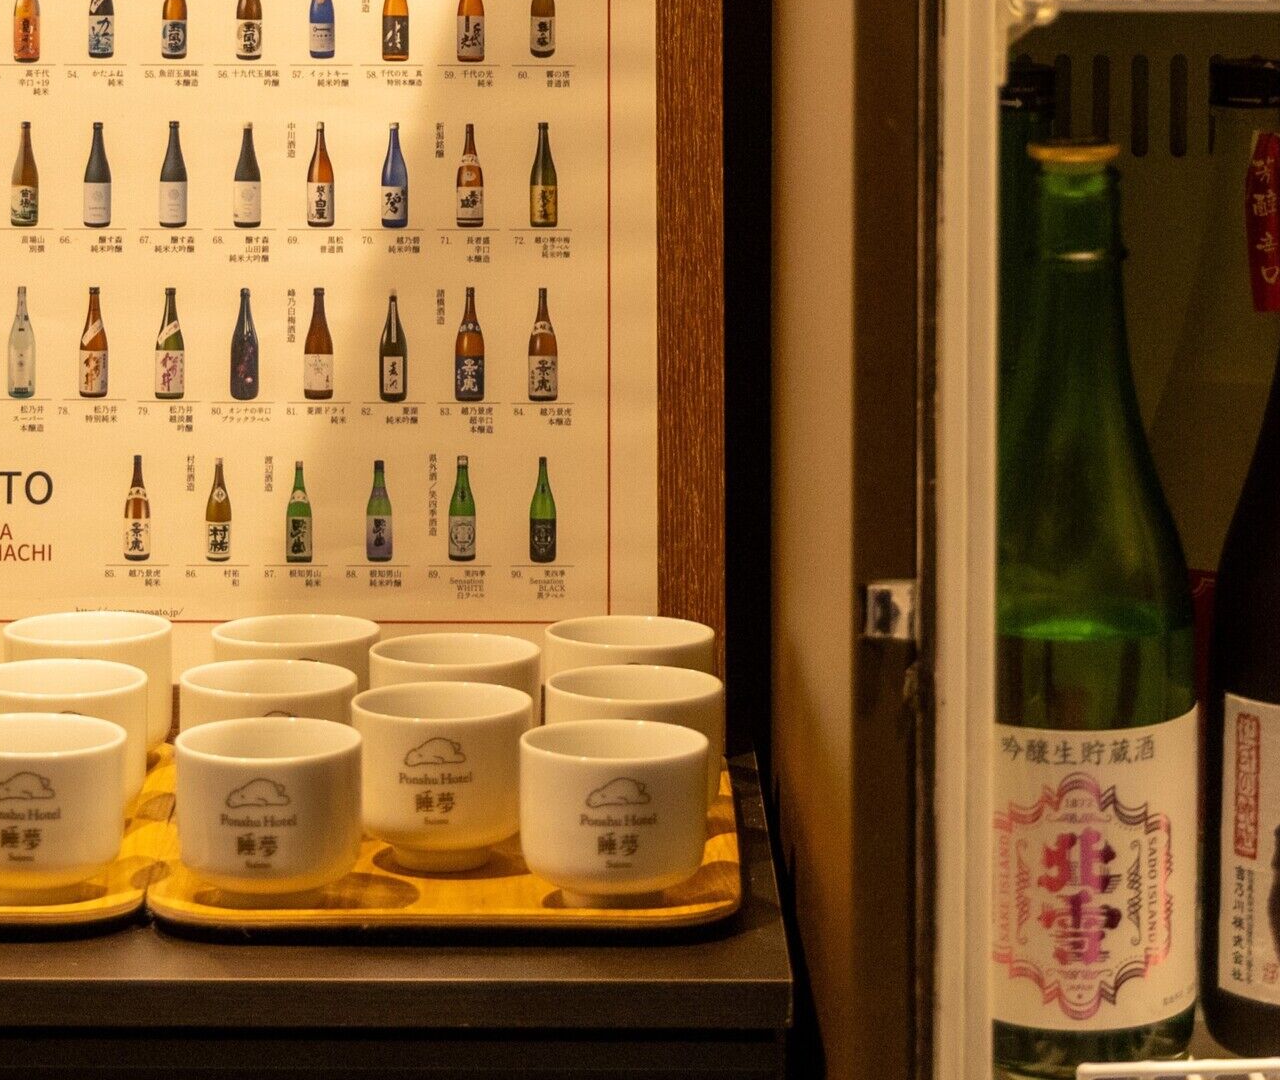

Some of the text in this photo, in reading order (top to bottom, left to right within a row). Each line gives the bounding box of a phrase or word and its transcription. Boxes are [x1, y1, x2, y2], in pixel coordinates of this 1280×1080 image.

[460, 68, 495, 81] 千代の光
[287, 123, 296, 158] 中川酒造
[19, 404, 45, 415] 松乃井
[210, 406, 224, 416] 80.
[512, 407, 526, 417] 84.
[103, 569, 117, 579] 85.
[184, 569, 198, 579] 86.
[263, 569, 277, 579] 87.
[427, 569, 441, 580] 89.
[510, 569, 524, 579] 90.
[304, 578, 322, 588] 純米
[448, 575, 485, 586] Sensation
[528, 575, 567, 586] Sensation
[456, 583, 485, 593] WHITE
[538, 583, 567, 593] BLACK
[1001, 735, 1155, 765] 吟醸生貯蔵酒
[399, 772, 473, 786] Ponshu Hotel
[27, 807, 61, 820] Hotel
[220, 814, 298, 828] Ponshu Hotel
[580, 814, 658, 828] Ponshu Hotel
[1147, 837, 1158, 949] SADO ISLAND
